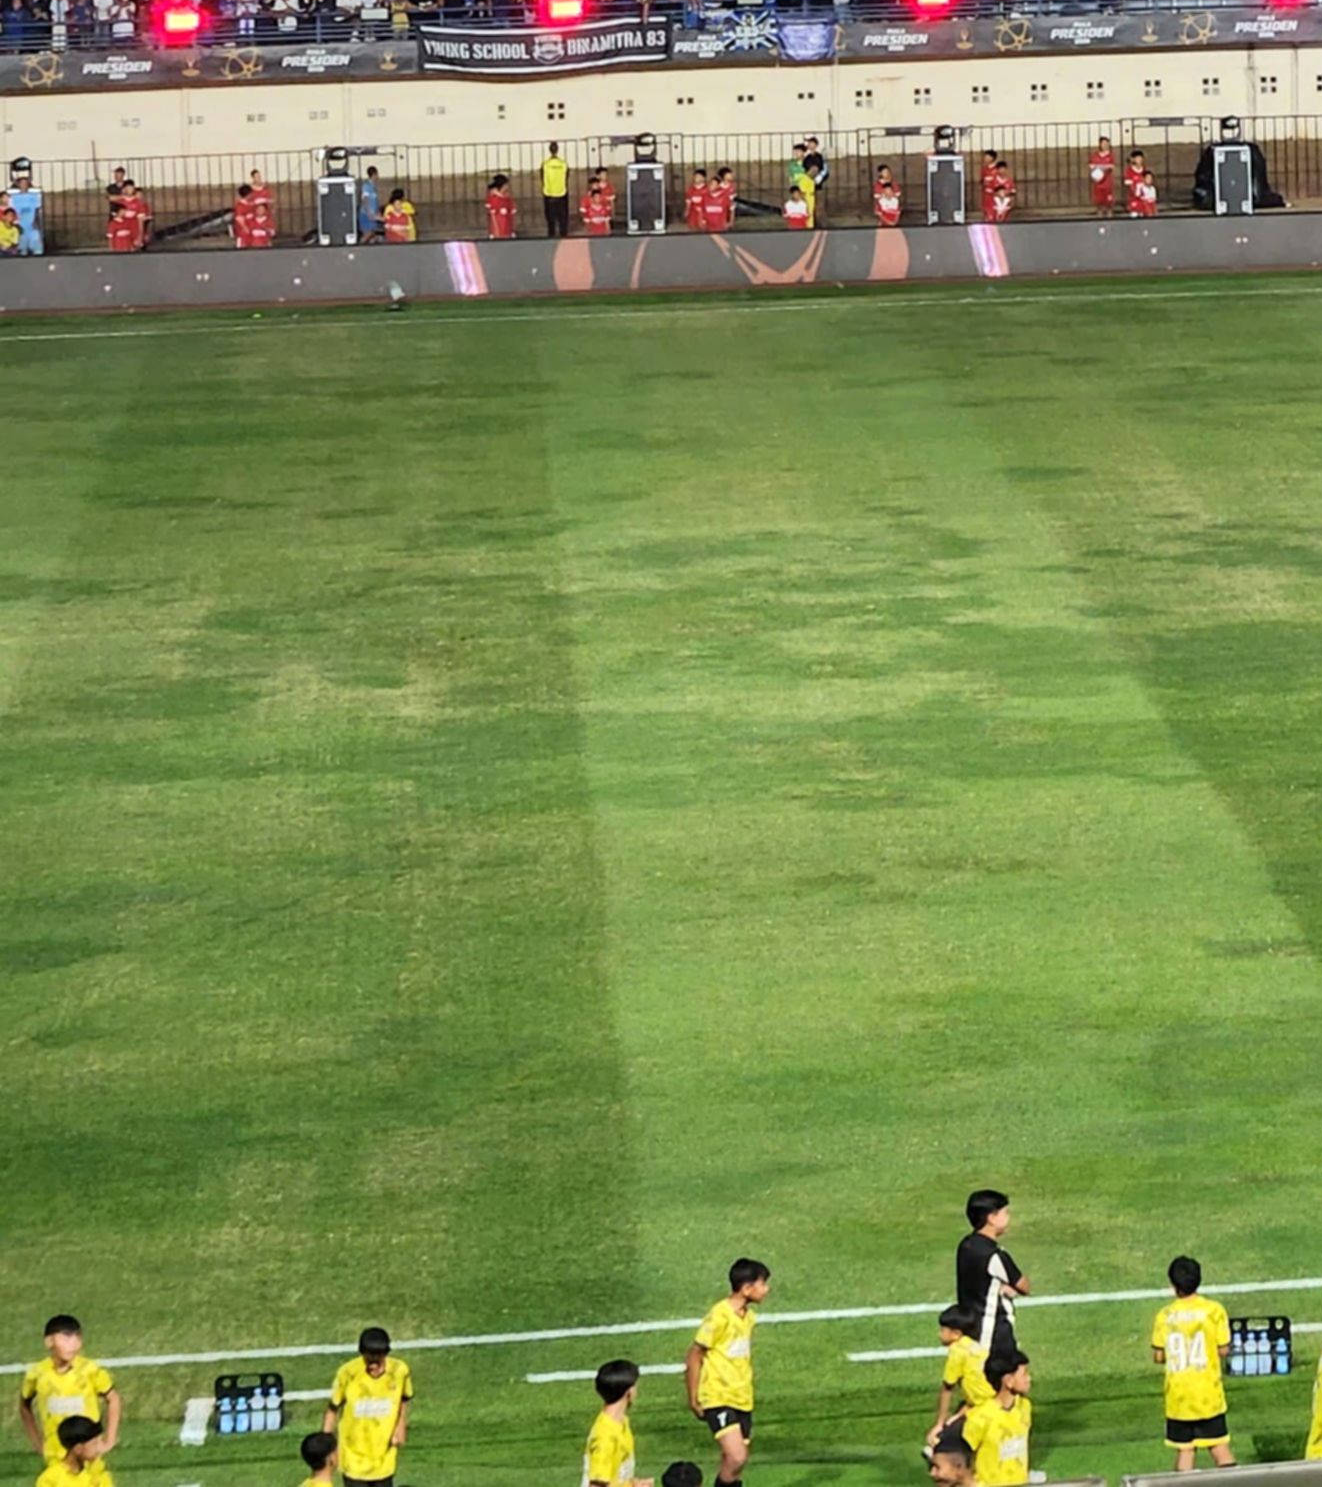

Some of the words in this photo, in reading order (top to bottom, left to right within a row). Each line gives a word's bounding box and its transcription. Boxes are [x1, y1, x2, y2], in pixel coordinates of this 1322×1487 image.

[473, 42, 530, 60] SCHOOL
[646, 30, 666, 47] 83
[1168, 1330, 1207, 1372] 94
